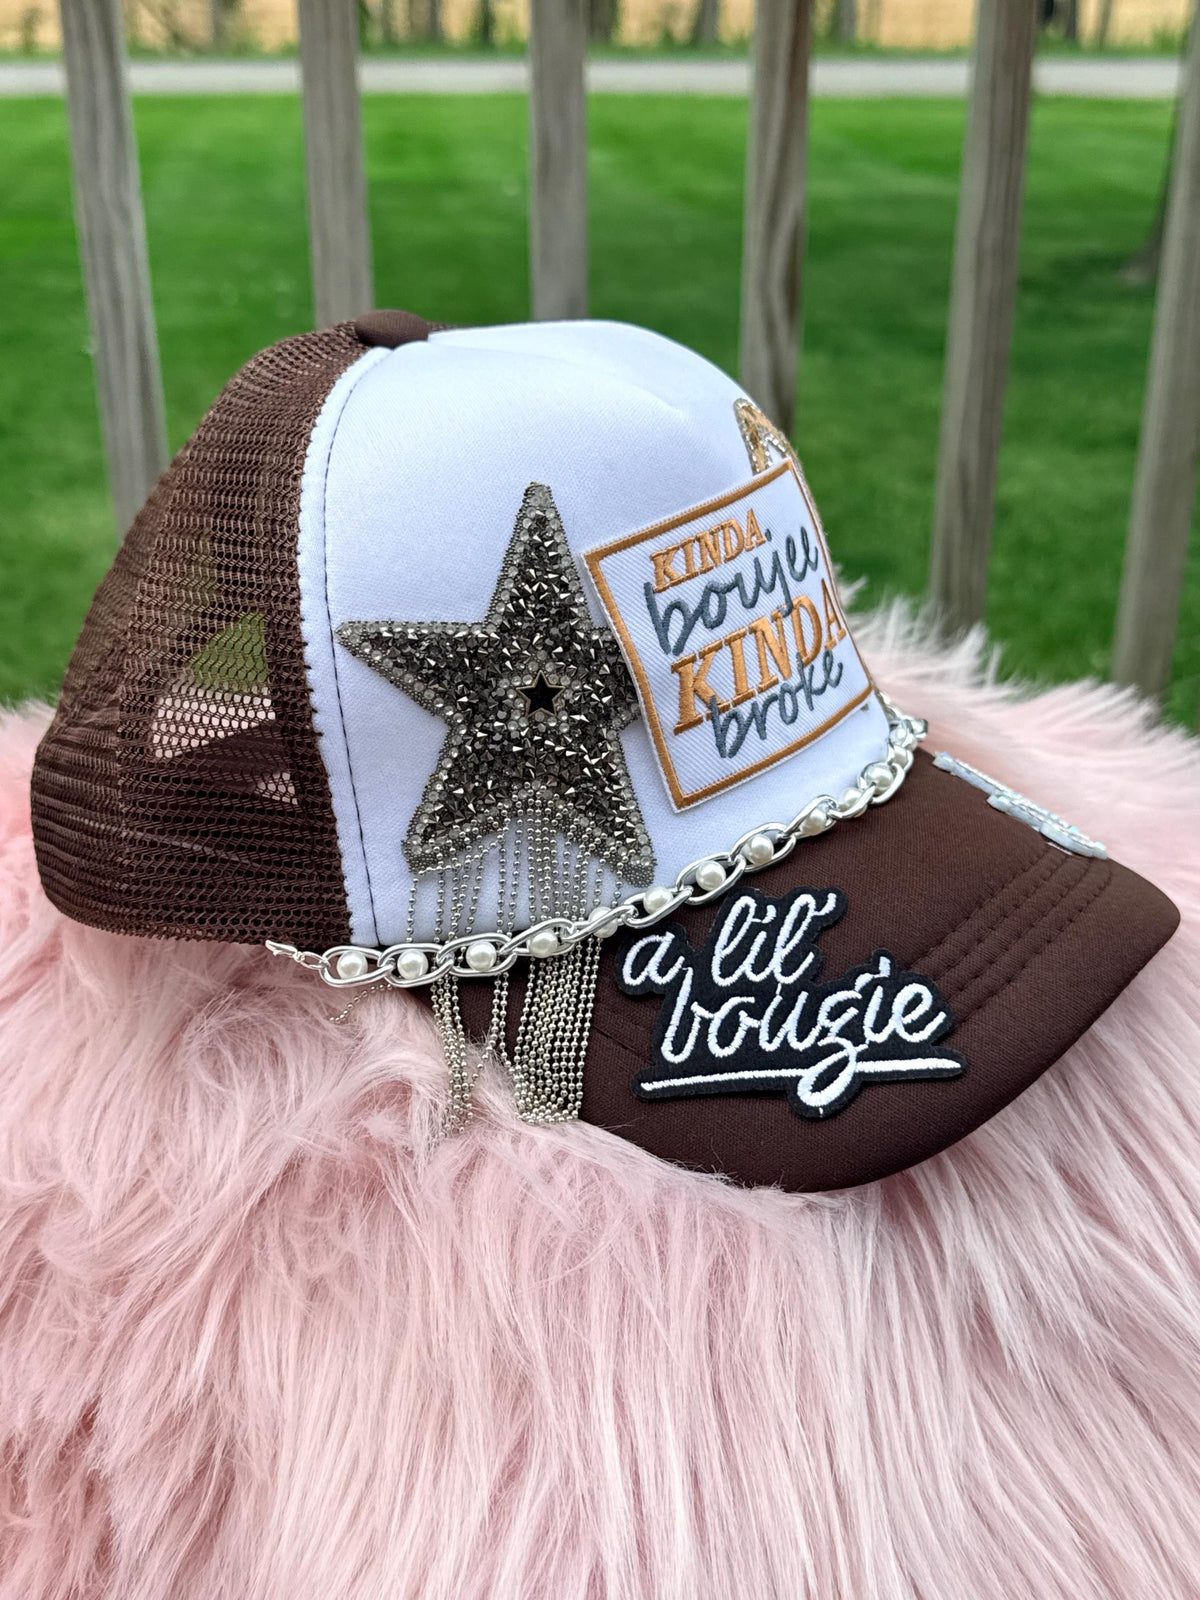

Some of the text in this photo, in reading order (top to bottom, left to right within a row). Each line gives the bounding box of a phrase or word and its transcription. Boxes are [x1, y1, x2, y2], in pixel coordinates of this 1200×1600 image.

[650, 508, 766, 592] KINDA
[671, 578, 847, 735] KINDA
[708, 650, 844, 759] broke
[622, 931, 684, 986] a
[660, 956, 947, 1107] bougie
